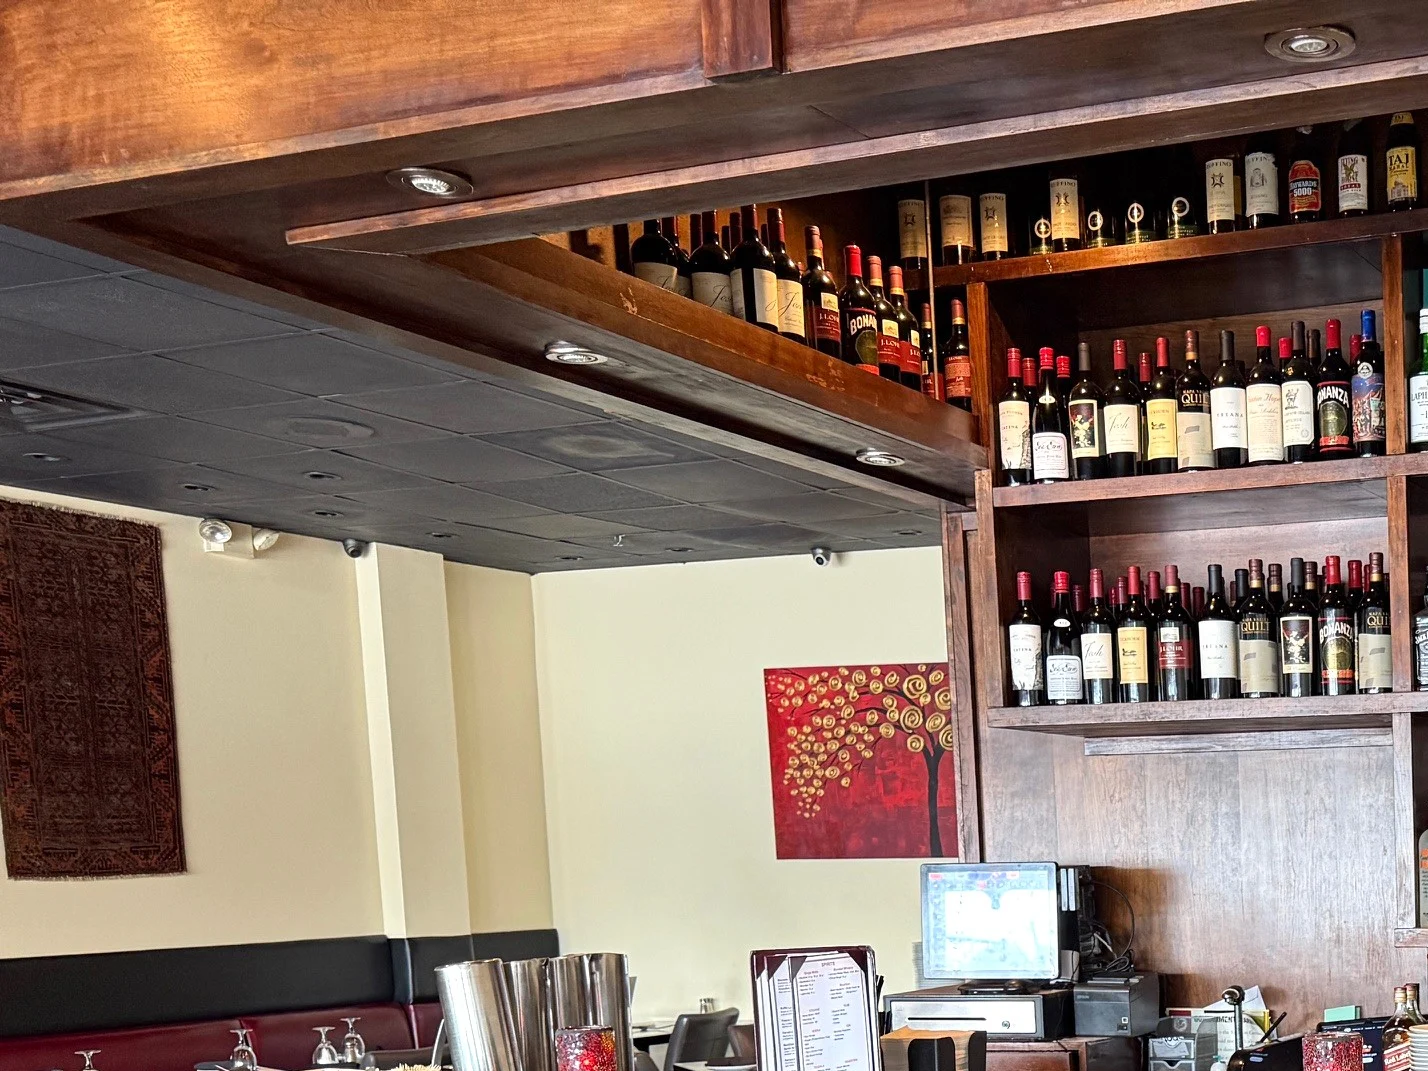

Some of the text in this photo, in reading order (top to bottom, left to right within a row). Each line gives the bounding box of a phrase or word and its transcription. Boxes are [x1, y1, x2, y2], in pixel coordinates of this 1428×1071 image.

[1388, 154, 1409, 165] TAJ
[1293, 188, 1312, 197] 5000
[850, 313, 877, 336] BONAN
[1241, 621, 1270, 632] QUILT
[1415, 633, 1426, 644] JACK
[1383, 1056, 1396, 1066] Red
